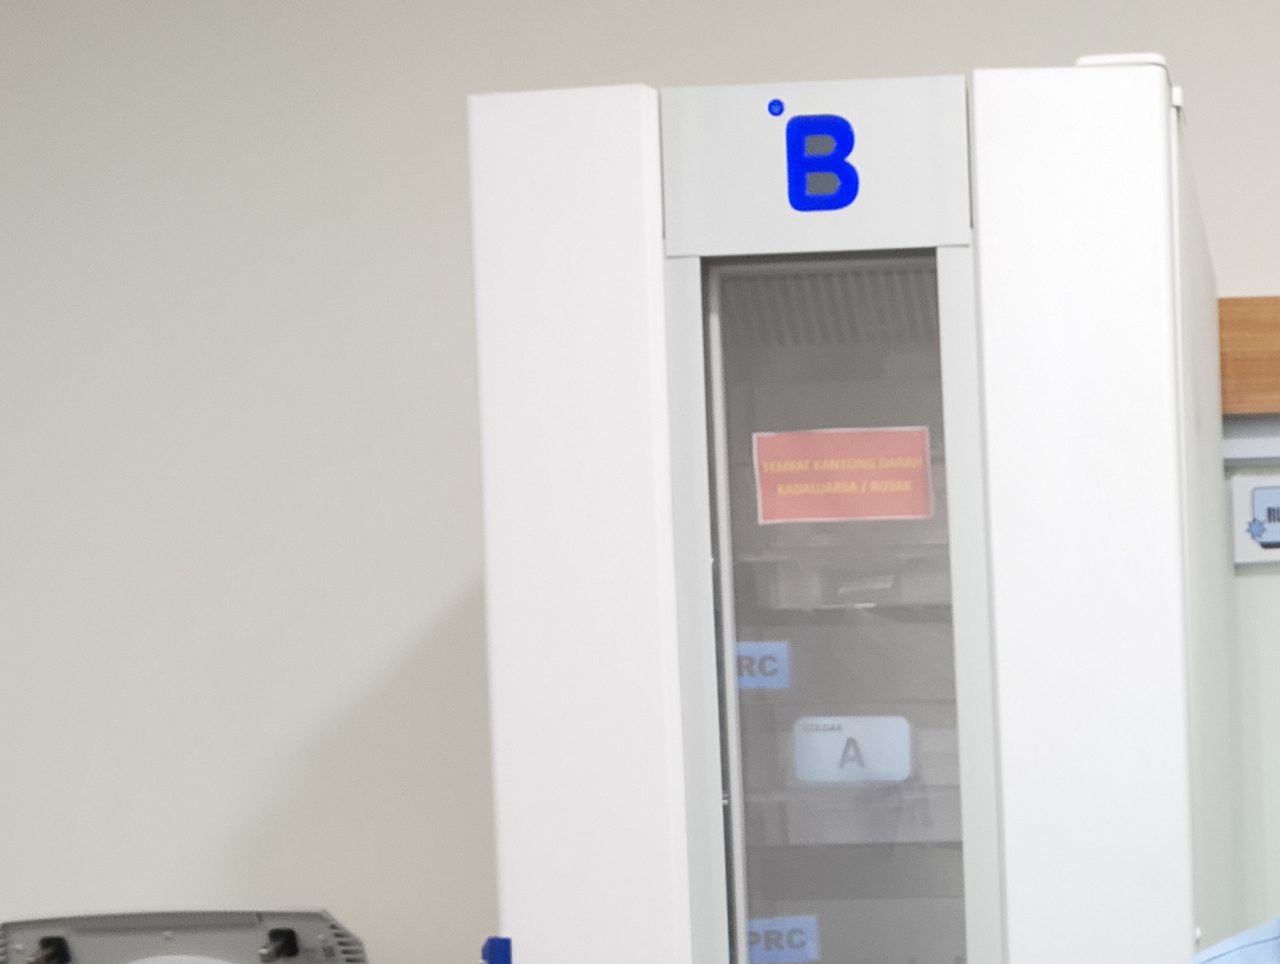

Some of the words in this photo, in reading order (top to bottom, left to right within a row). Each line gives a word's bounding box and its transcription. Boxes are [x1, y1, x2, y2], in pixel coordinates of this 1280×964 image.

[762, 460, 810, 474] TEMPAT
[813, 458, 876, 472] KANTONG
[878, 456, 923, 470] DARAH
[870, 479, 914, 493] RUSAK
[839, 736, 866, 769] A
